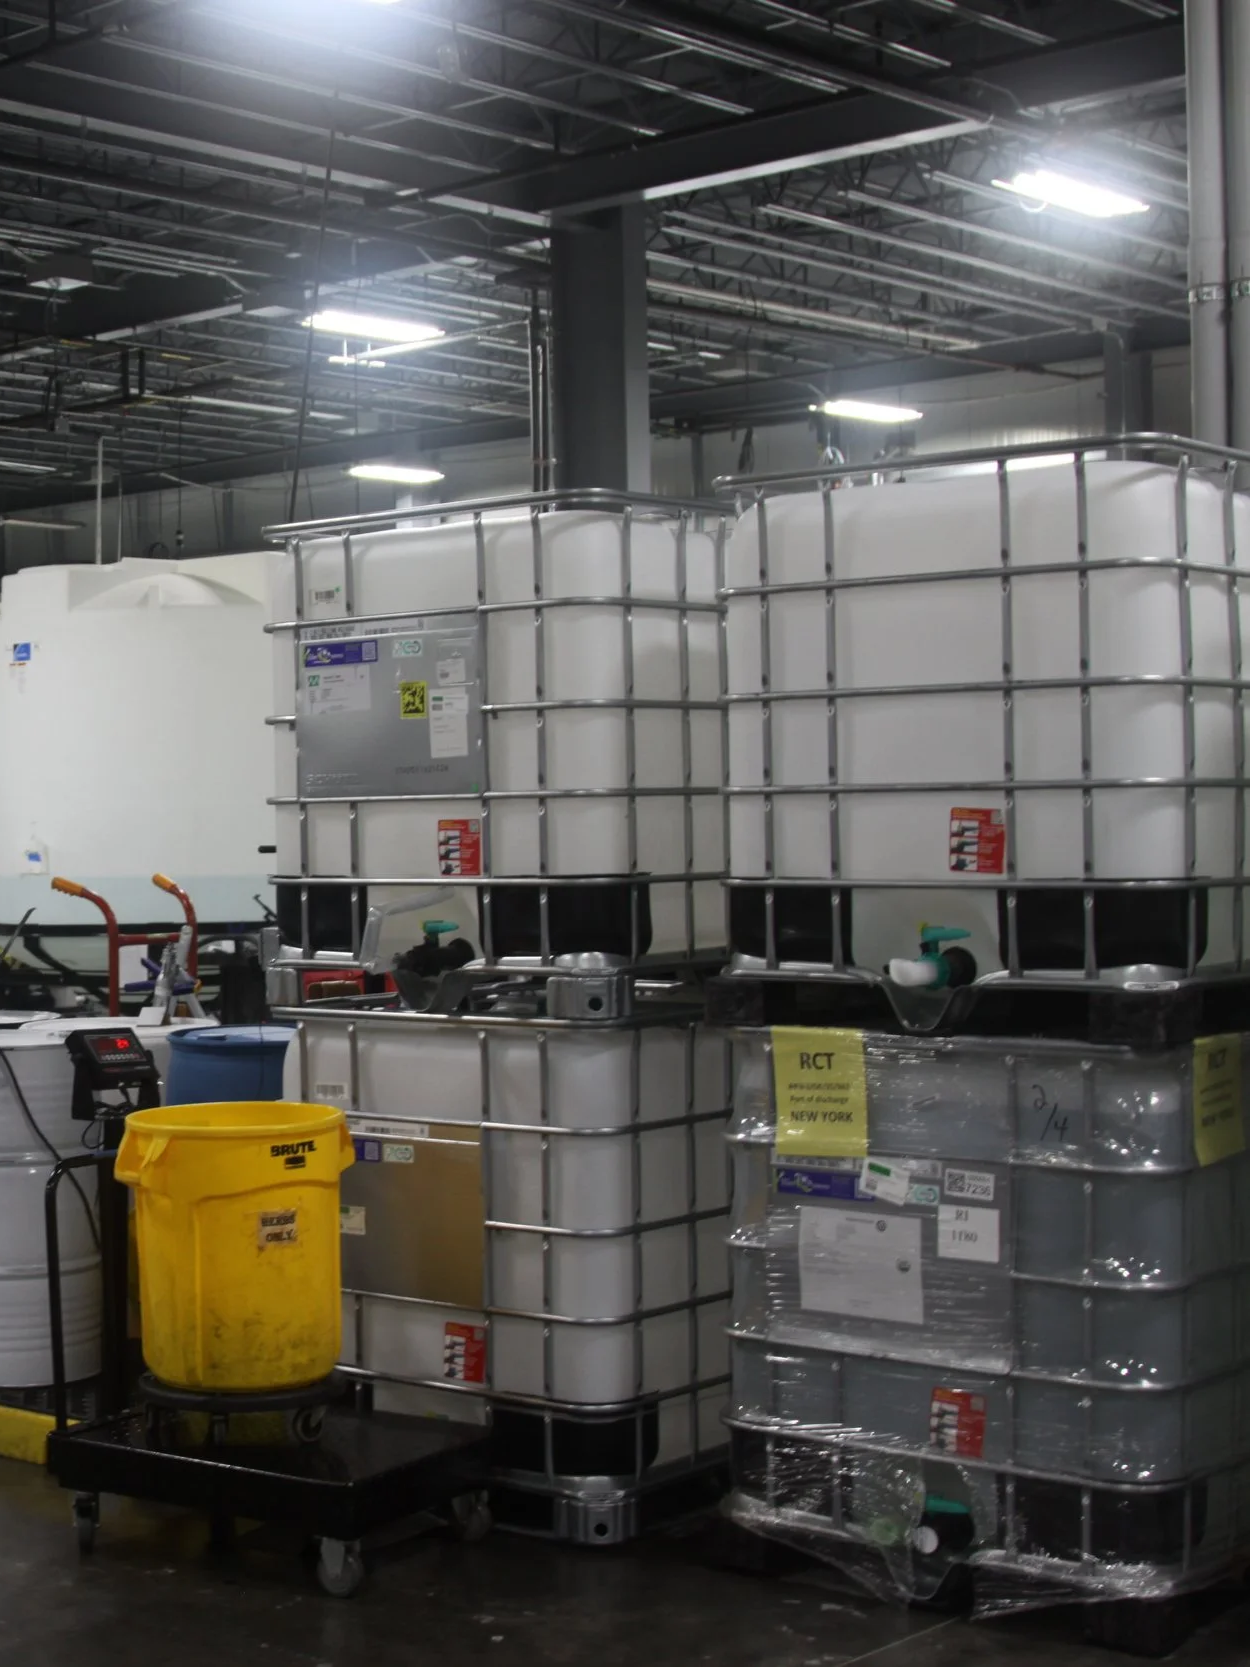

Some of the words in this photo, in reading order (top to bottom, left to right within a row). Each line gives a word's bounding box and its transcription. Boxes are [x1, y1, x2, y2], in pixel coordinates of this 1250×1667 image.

[799, 1052, 835, 1070] RCT
[790, 1110, 818, 1122] NEW
[822, 1111, 854, 1123] YORK
[1032, 1084, 1069, 1142] 2/4
[270, 1140, 316, 1156] BRUTE
